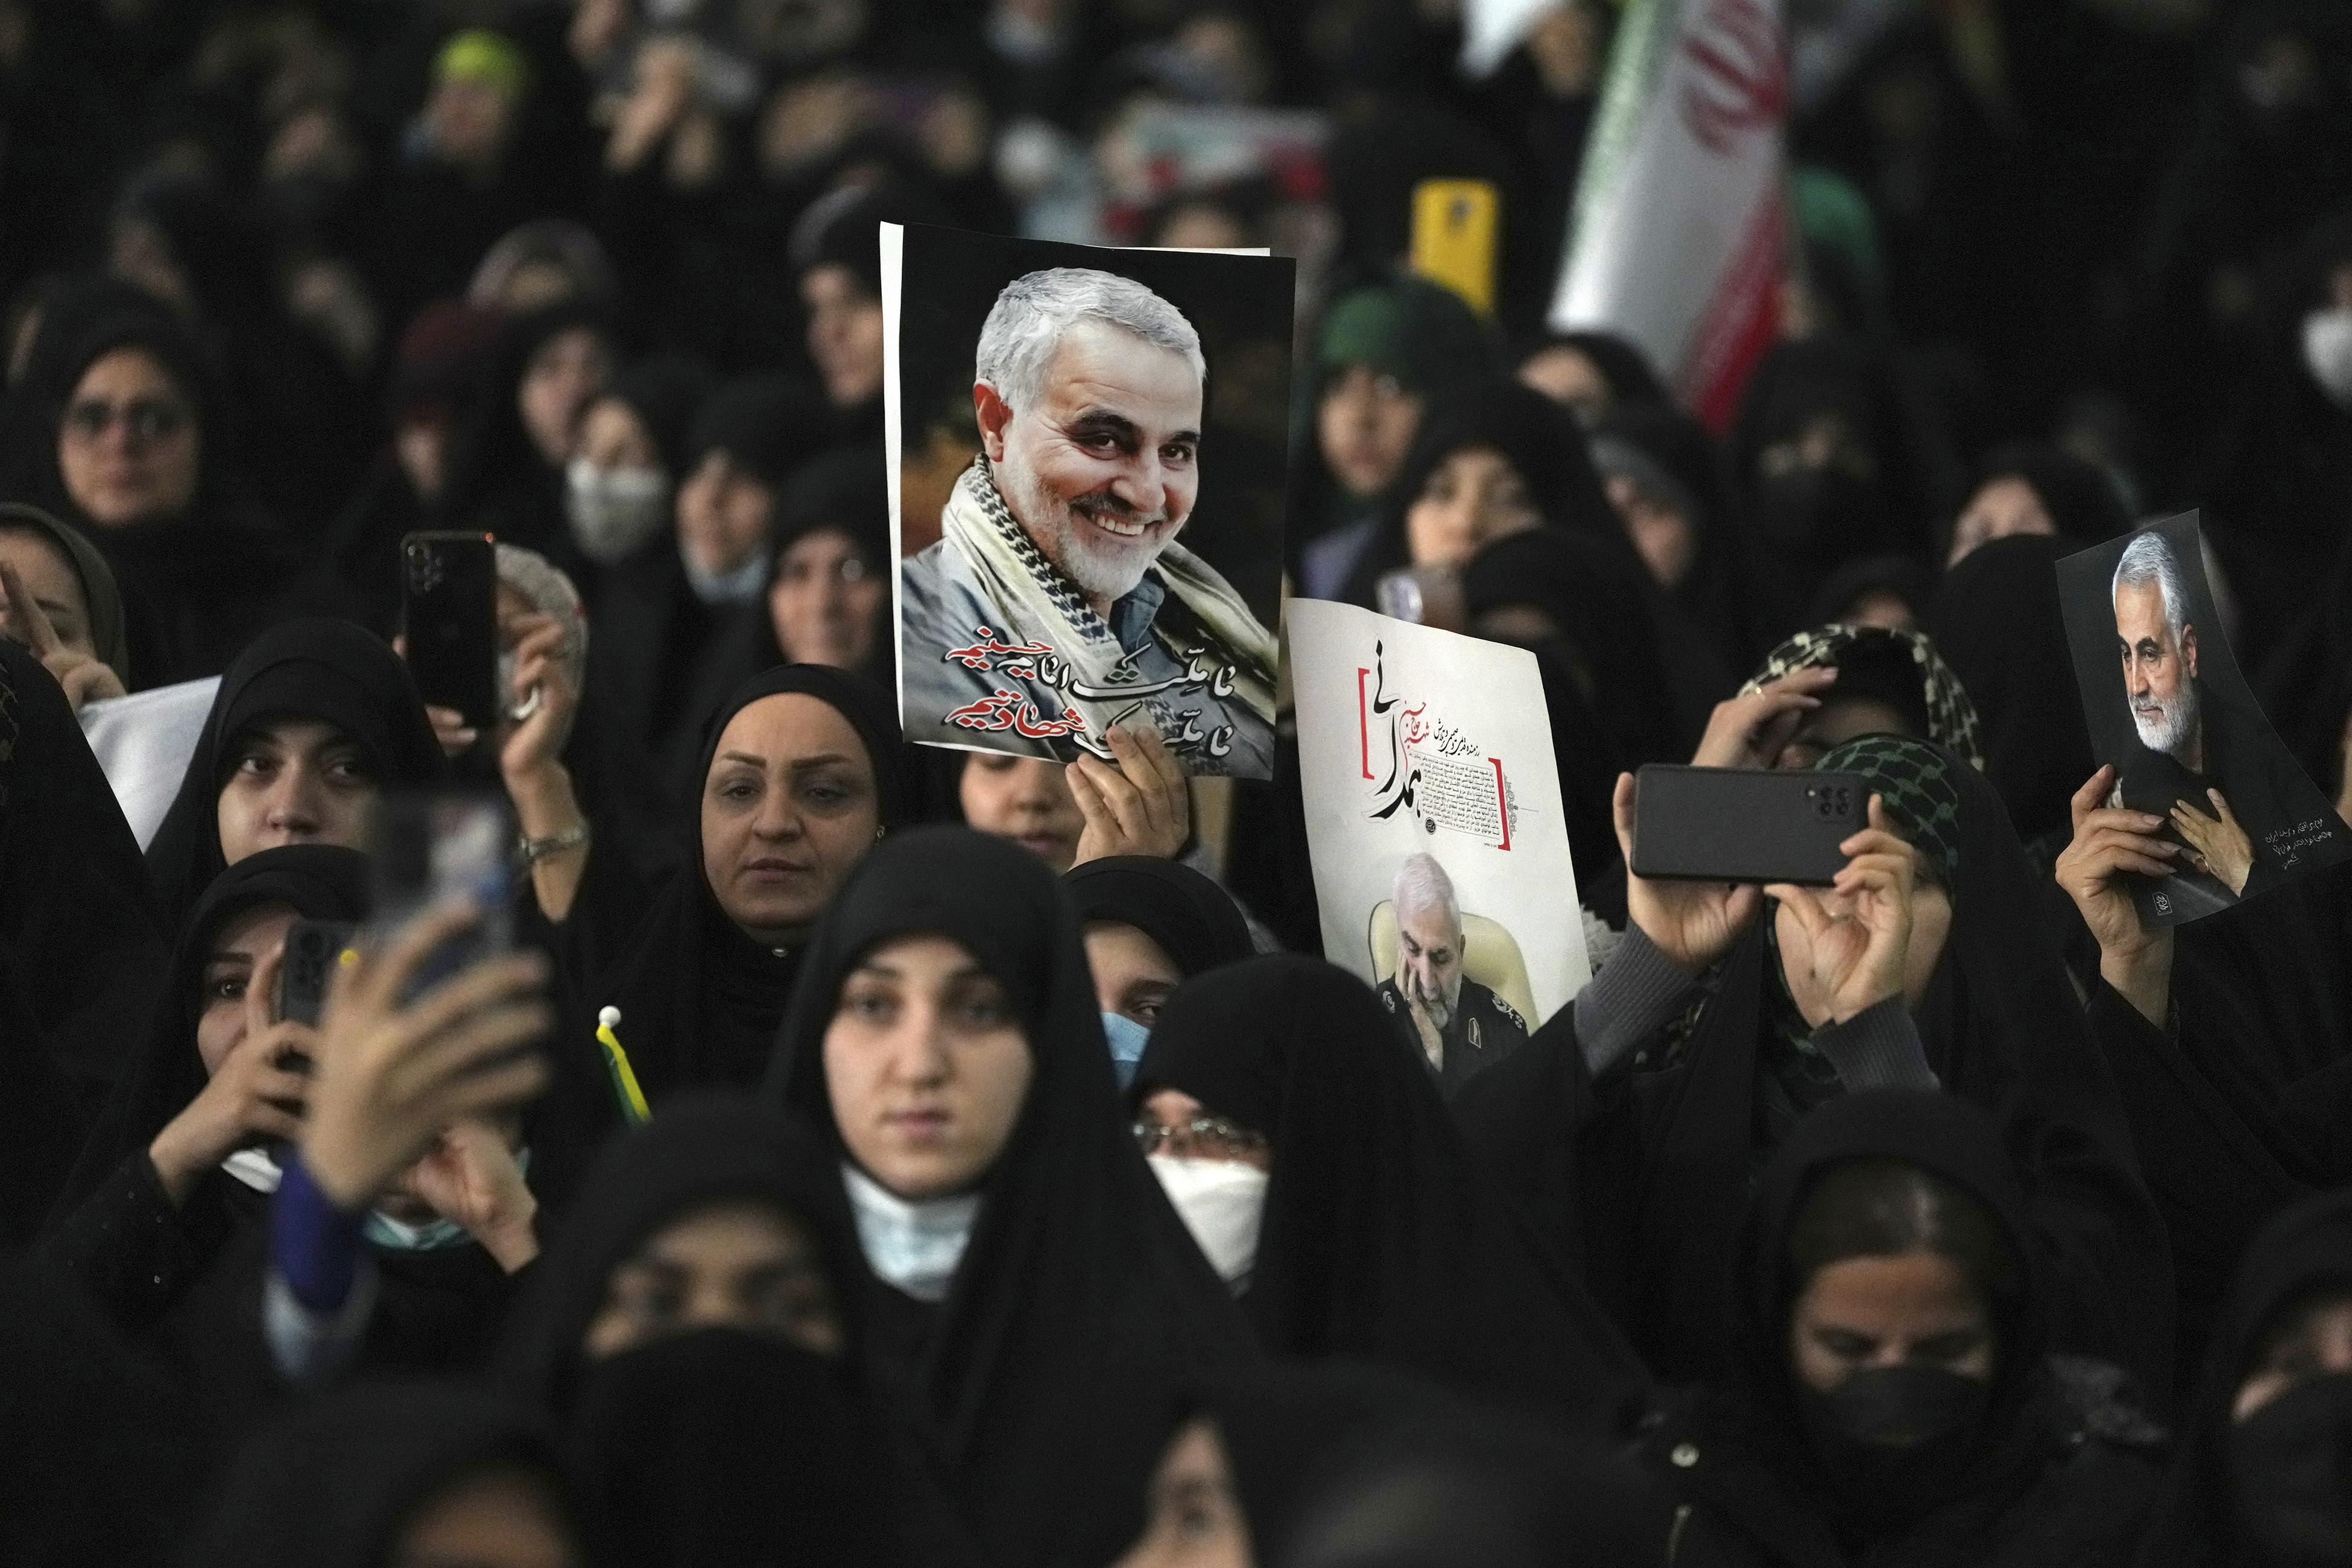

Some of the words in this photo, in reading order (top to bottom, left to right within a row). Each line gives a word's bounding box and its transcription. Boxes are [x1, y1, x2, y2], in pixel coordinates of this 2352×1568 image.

[944, 625, 1054, 679] حسینیم
[997, 656, 1071, 688] امام
[1213, 665, 1236, 697] ما
[944, 688, 1086, 738] شهادتیم
[1210, 726, 1234, 756] ما
